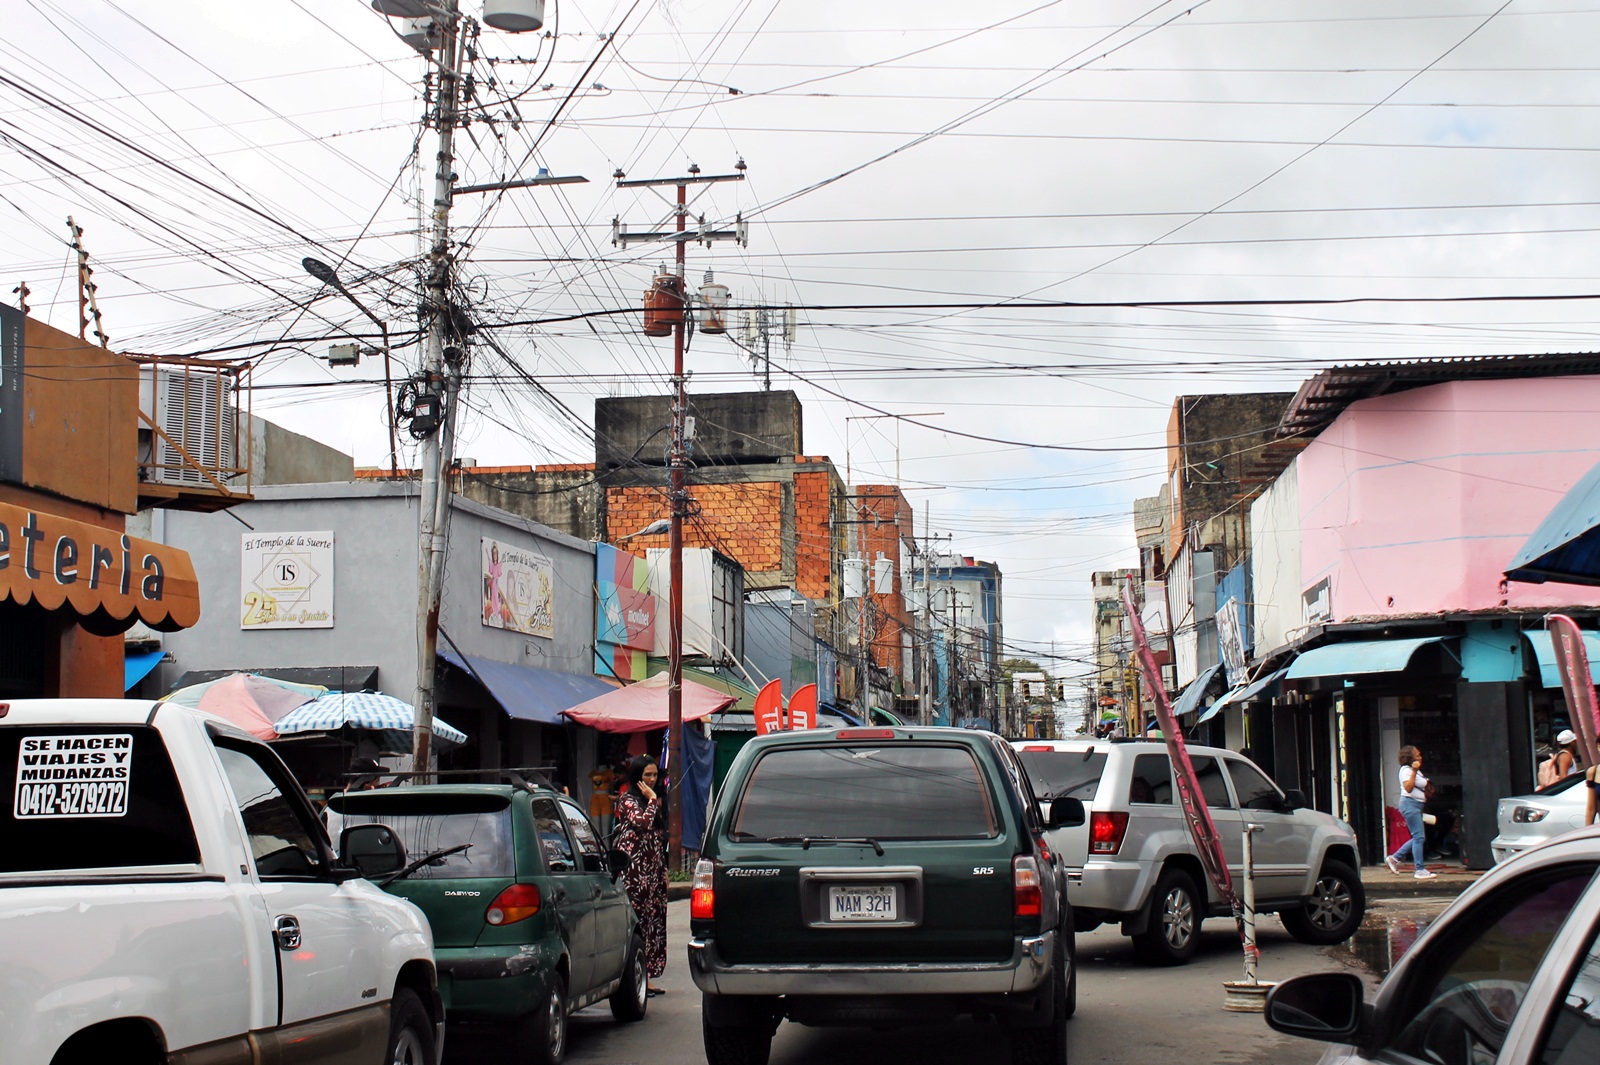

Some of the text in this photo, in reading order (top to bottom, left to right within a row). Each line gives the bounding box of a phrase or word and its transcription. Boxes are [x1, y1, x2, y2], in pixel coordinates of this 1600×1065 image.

[245, 536, 332, 551] El Templo de la Suerte
[276, 564, 296, 581] TS
[243, 591, 277, 625] 25
[24, 738, 130, 751] SE HACEN
[1339, 714, 1347, 765] ORO
[23, 752, 128, 765] VIAJES Y
[21, 767, 127, 780] MUDANZAS
[20, 782, 124, 815] 0412-5279272
[972, 866, 994, 875] SR5
[835, 895, 891, 912] NAM 32H
